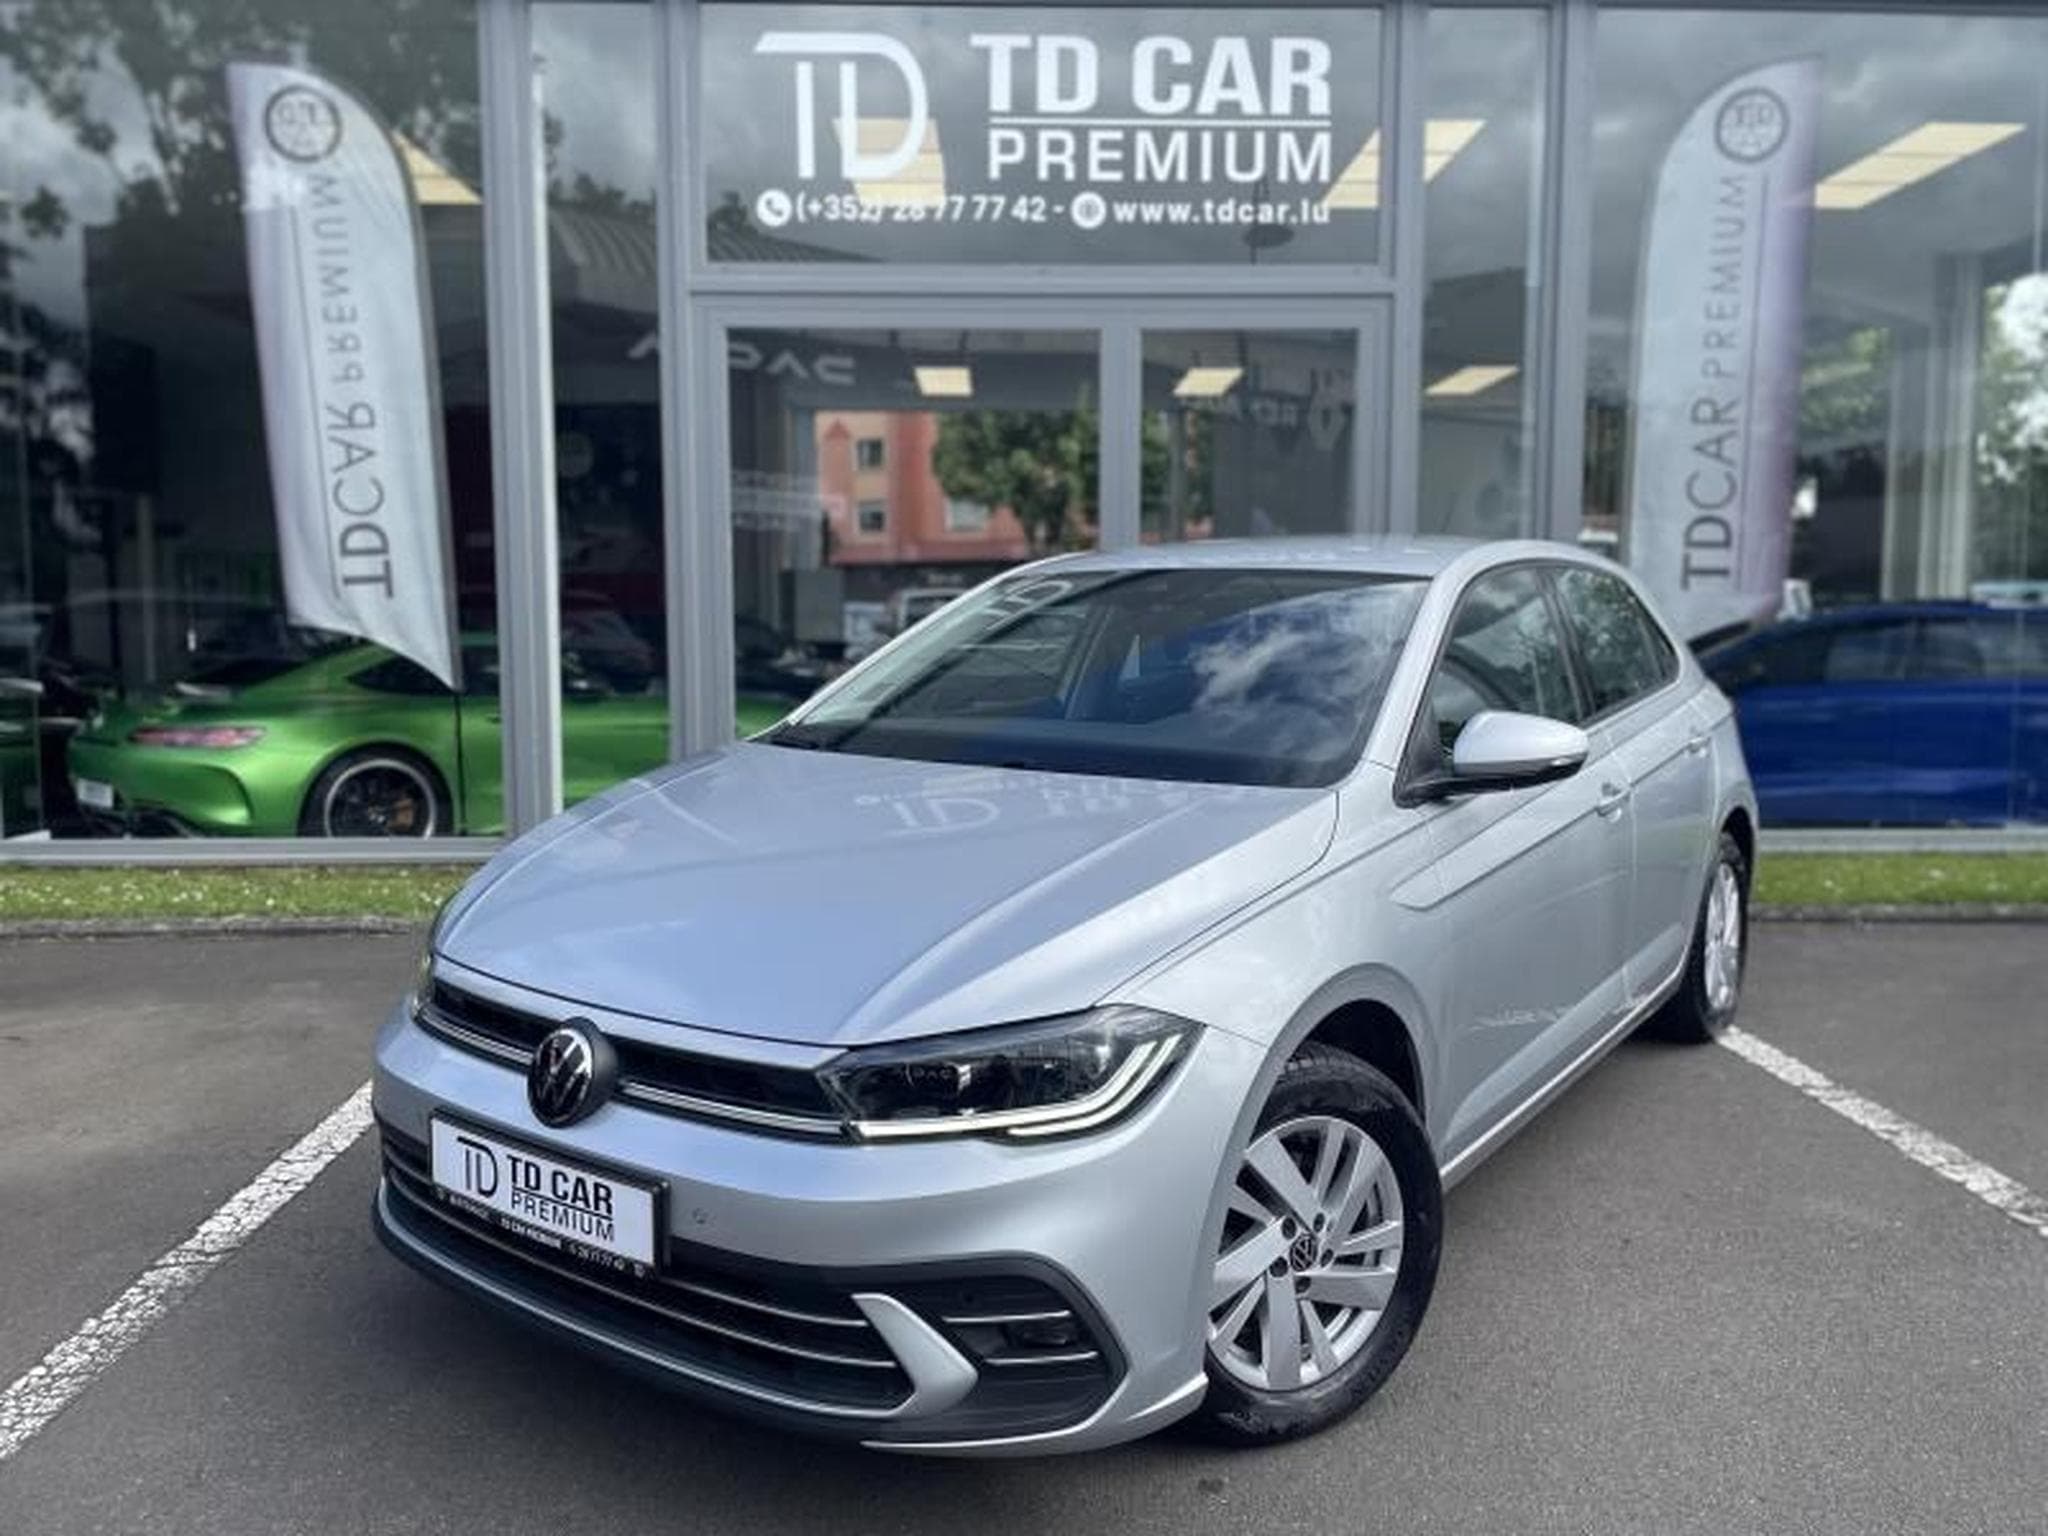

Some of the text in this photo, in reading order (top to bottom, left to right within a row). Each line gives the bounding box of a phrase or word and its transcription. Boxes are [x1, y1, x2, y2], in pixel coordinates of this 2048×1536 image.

[969, 34, 1331, 115] TD CAR
[989, 128, 1331, 182] PREMIUM
[972, 196, 1005, 221] 77
[1010, 196, 1046, 222] 42
[1112, 198, 1331, 223] www.tdcar.lu
[1701, 175, 1748, 380] PREMIUM
[507, 1154, 613, 1215] TD CAR
[511, 1191, 615, 1242] PREMIUM
